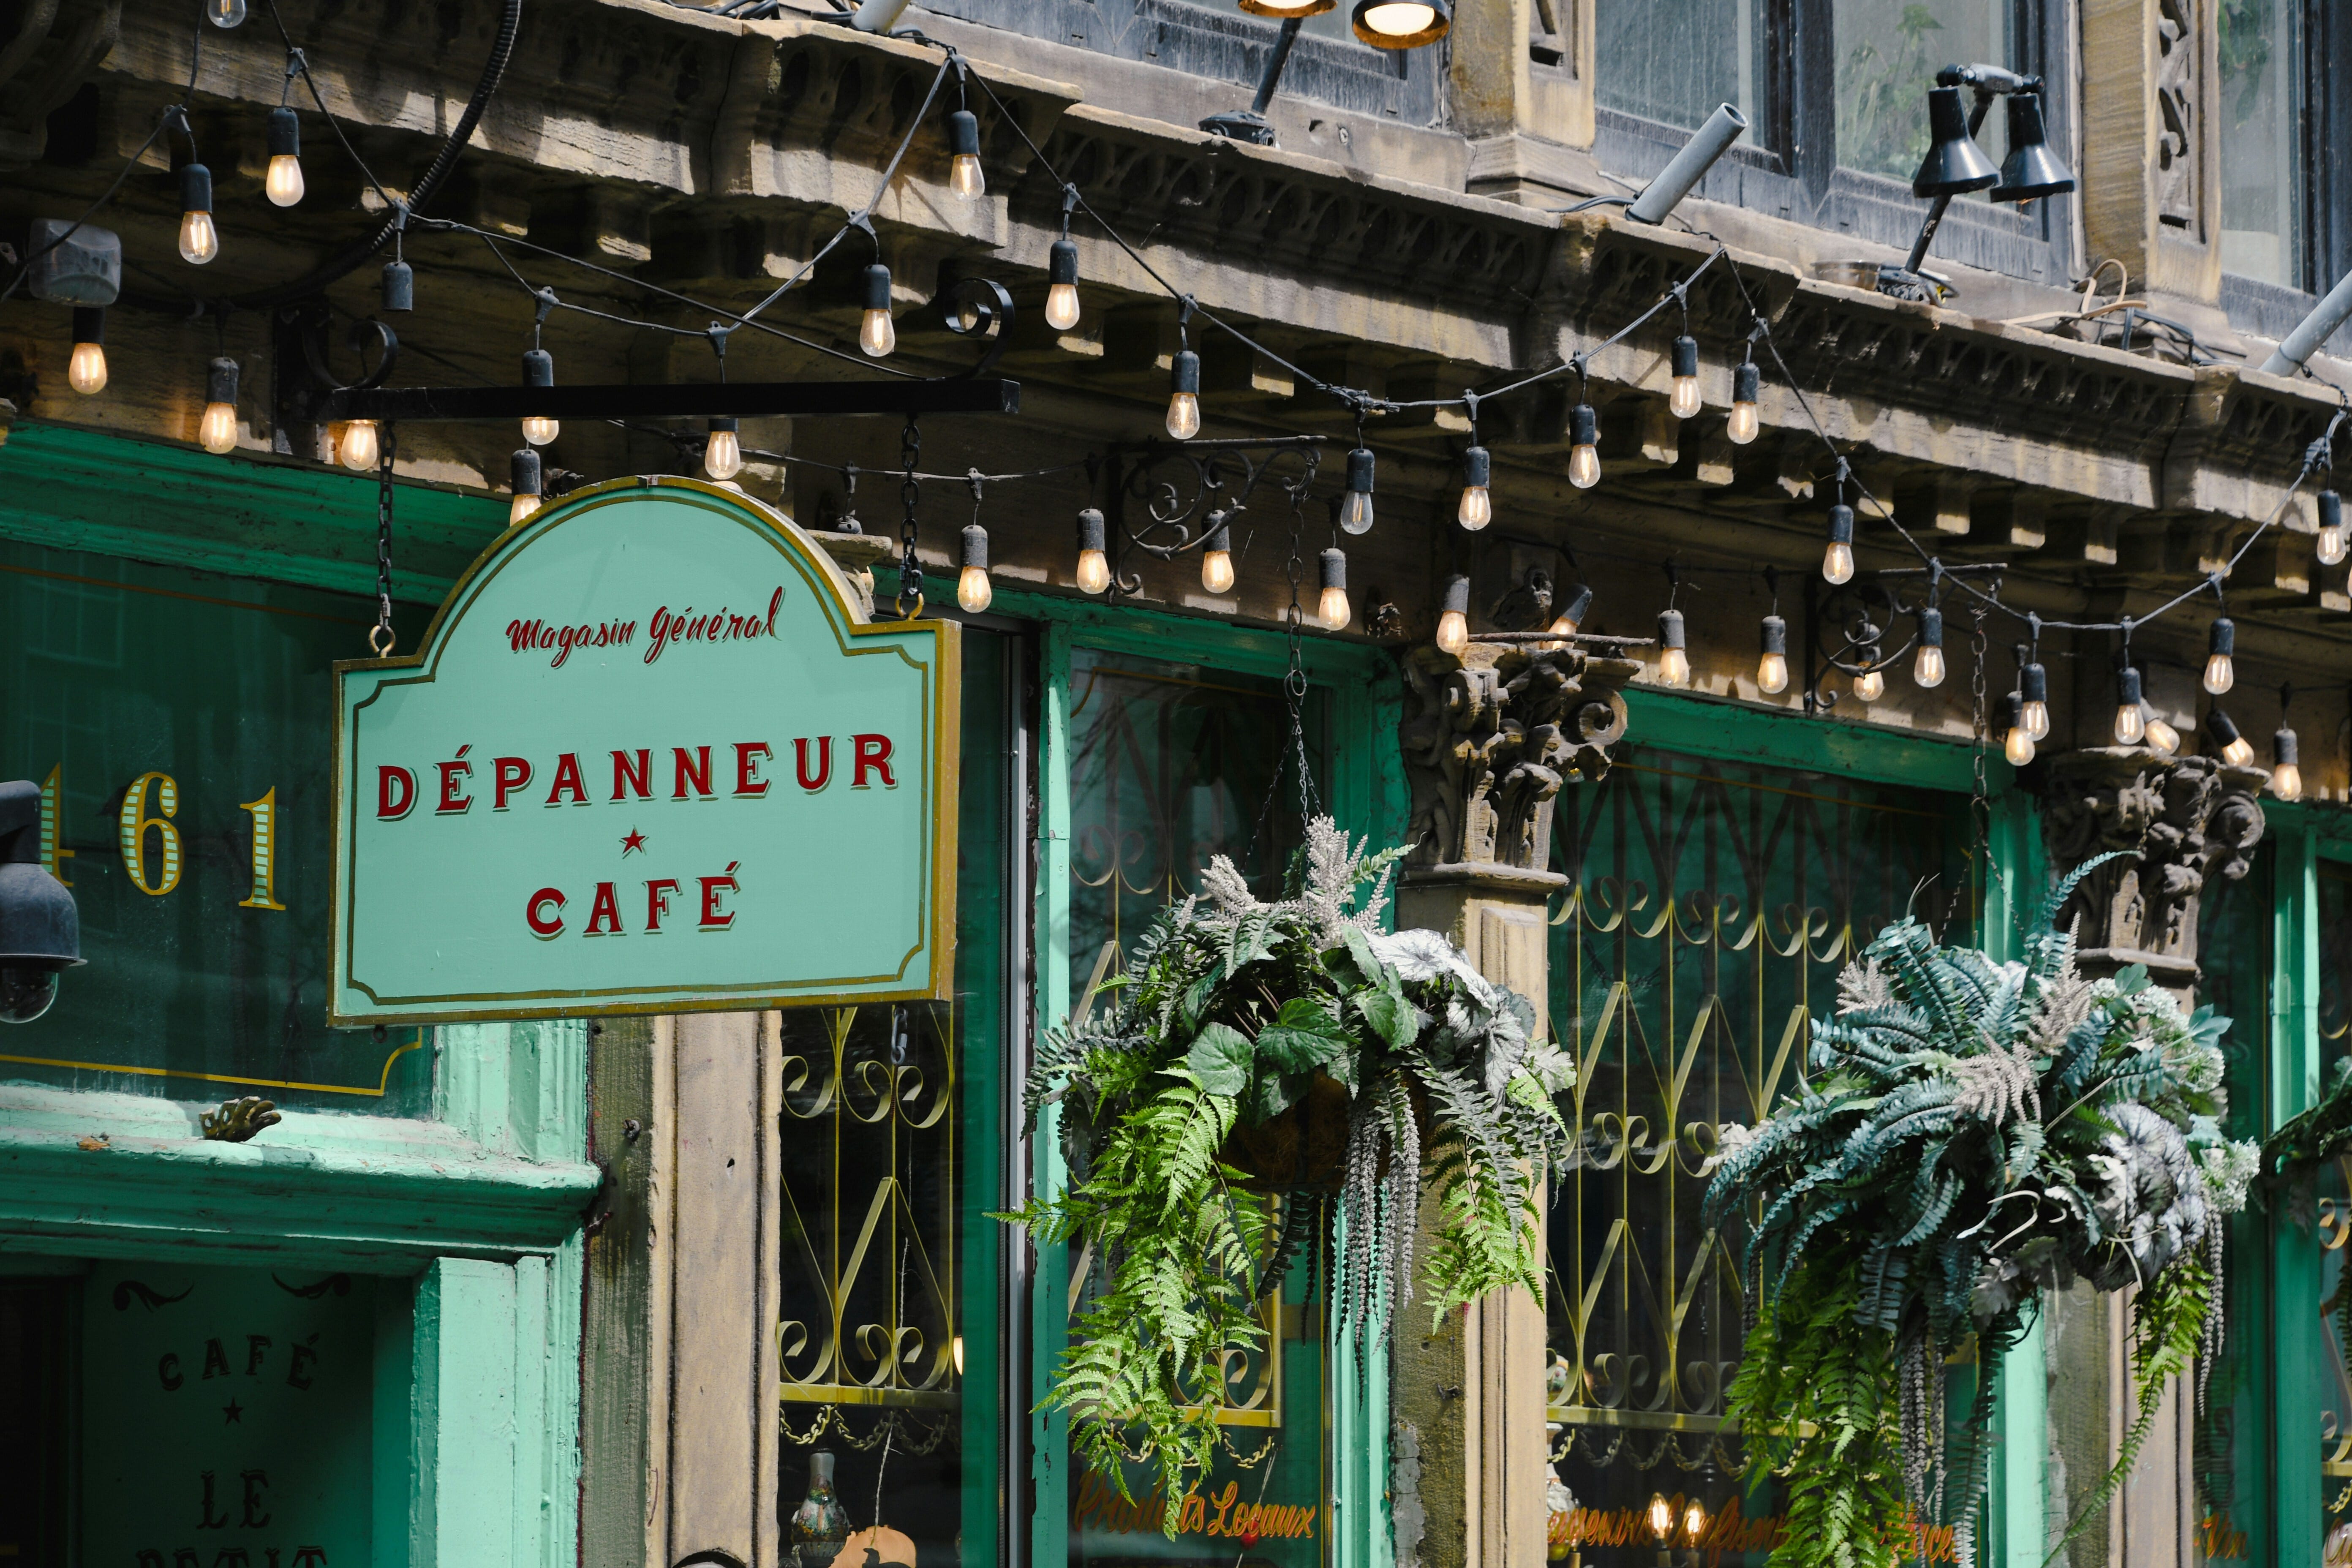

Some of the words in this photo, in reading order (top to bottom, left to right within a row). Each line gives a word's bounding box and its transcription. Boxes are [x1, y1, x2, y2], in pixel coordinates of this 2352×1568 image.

[505, 619, 636, 668] Magasin
[645, 586, 784, 665] Général
[376, 734, 898, 820] DÉPANNEUR
[526, 860, 741, 941] CAFÉ
[158, 1333, 320, 1391] CAFÉ
[196, 1469, 272, 1530] LE
[1075, 1467, 1206, 1535] Prodts
[1207, 1480, 1316, 1539] Locaux
[1547, 1506, 1656, 1549] uvenirs
